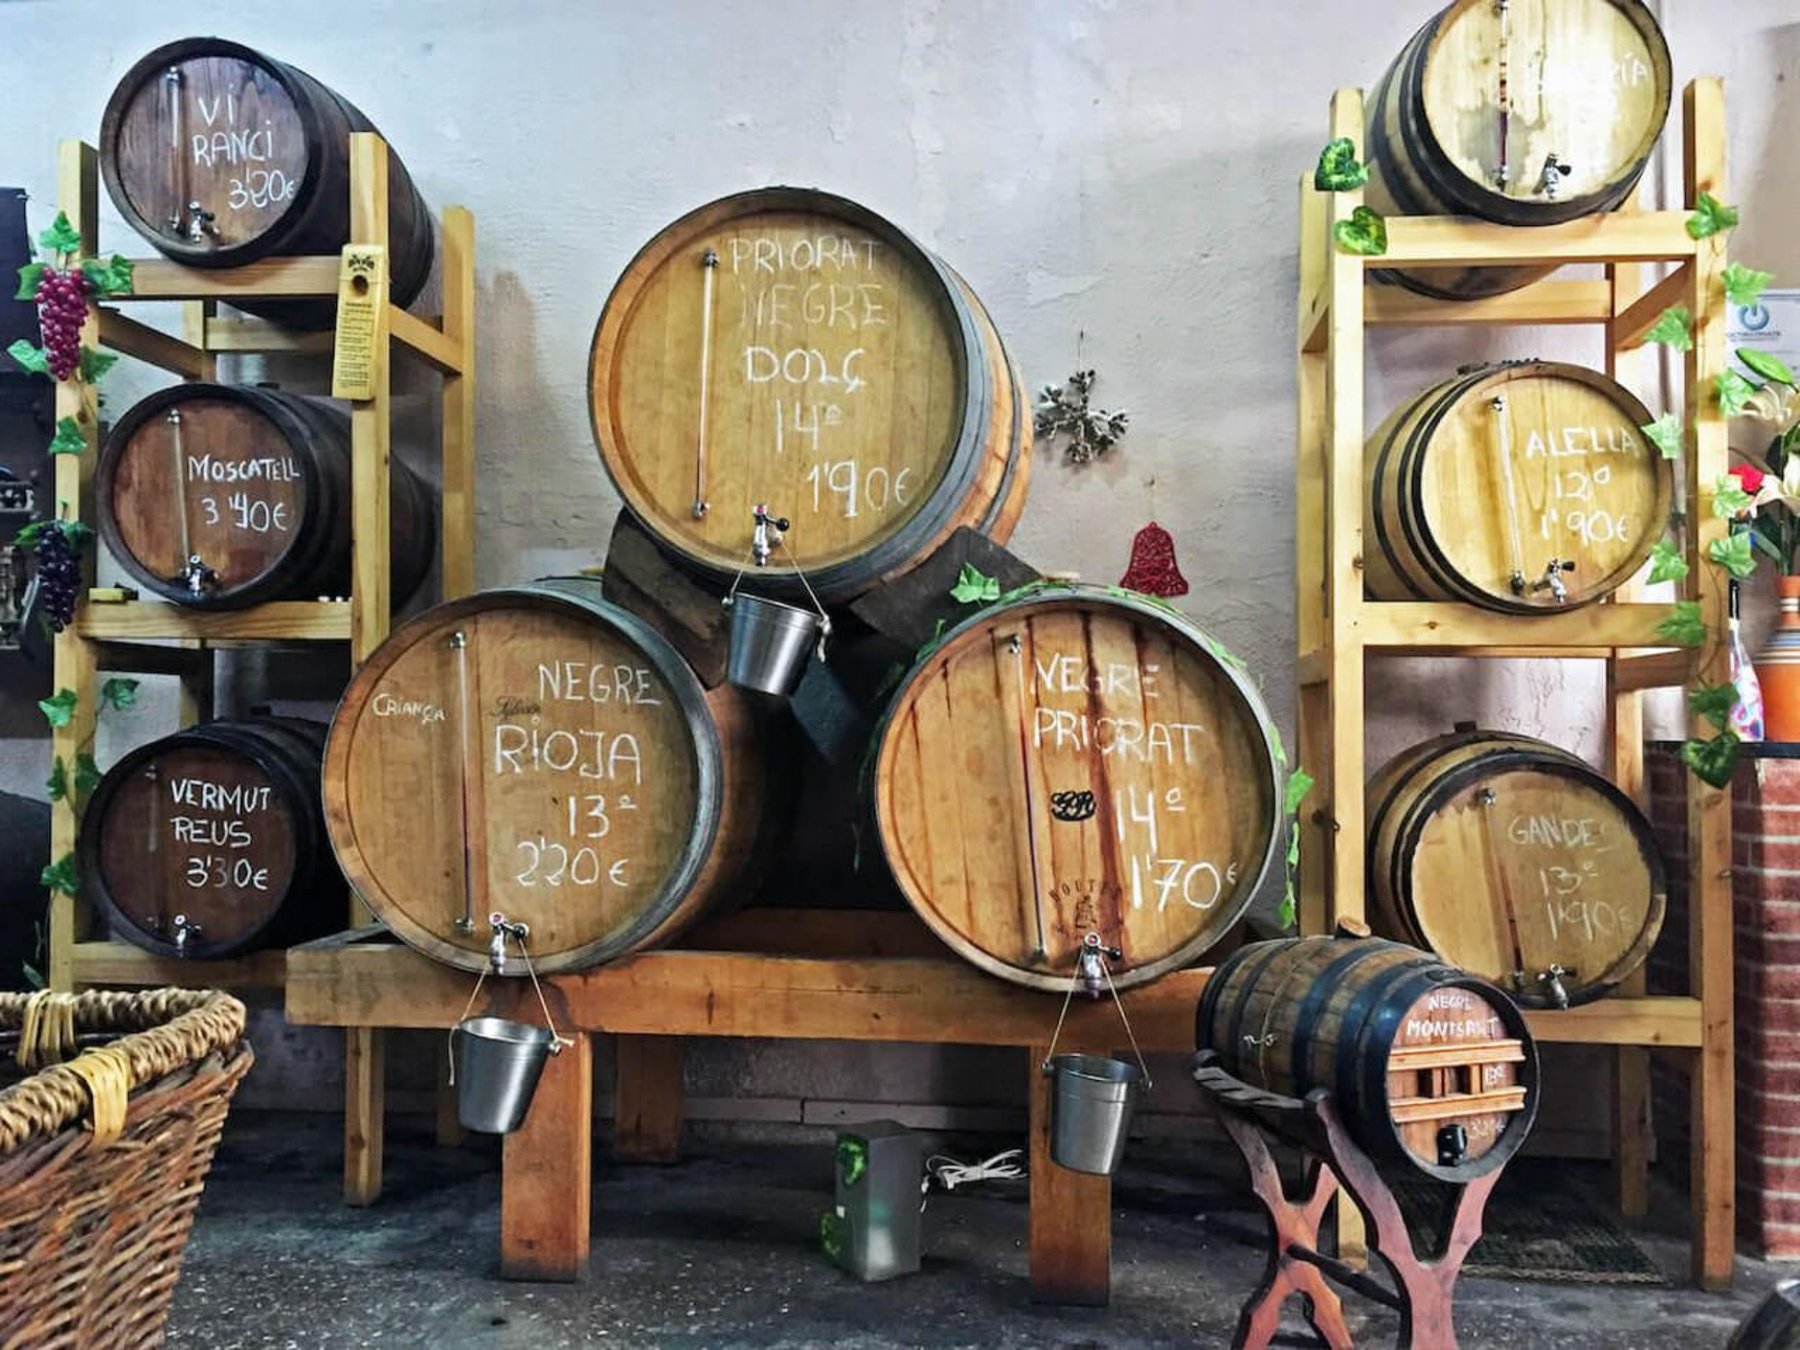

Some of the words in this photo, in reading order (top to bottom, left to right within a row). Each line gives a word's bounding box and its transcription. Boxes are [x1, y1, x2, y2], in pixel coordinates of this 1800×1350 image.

[728, 235, 880, 275] PRIORAT
[743, 346, 866, 394] DOLÇ
[1525, 426, 1640, 459] ALELLA
[538, 660, 661, 706] NEGRE
[1034, 706, 1204, 765] PRIORAT
[171, 778, 271, 815] VERMUT
[170, 816, 251, 848] REUS
